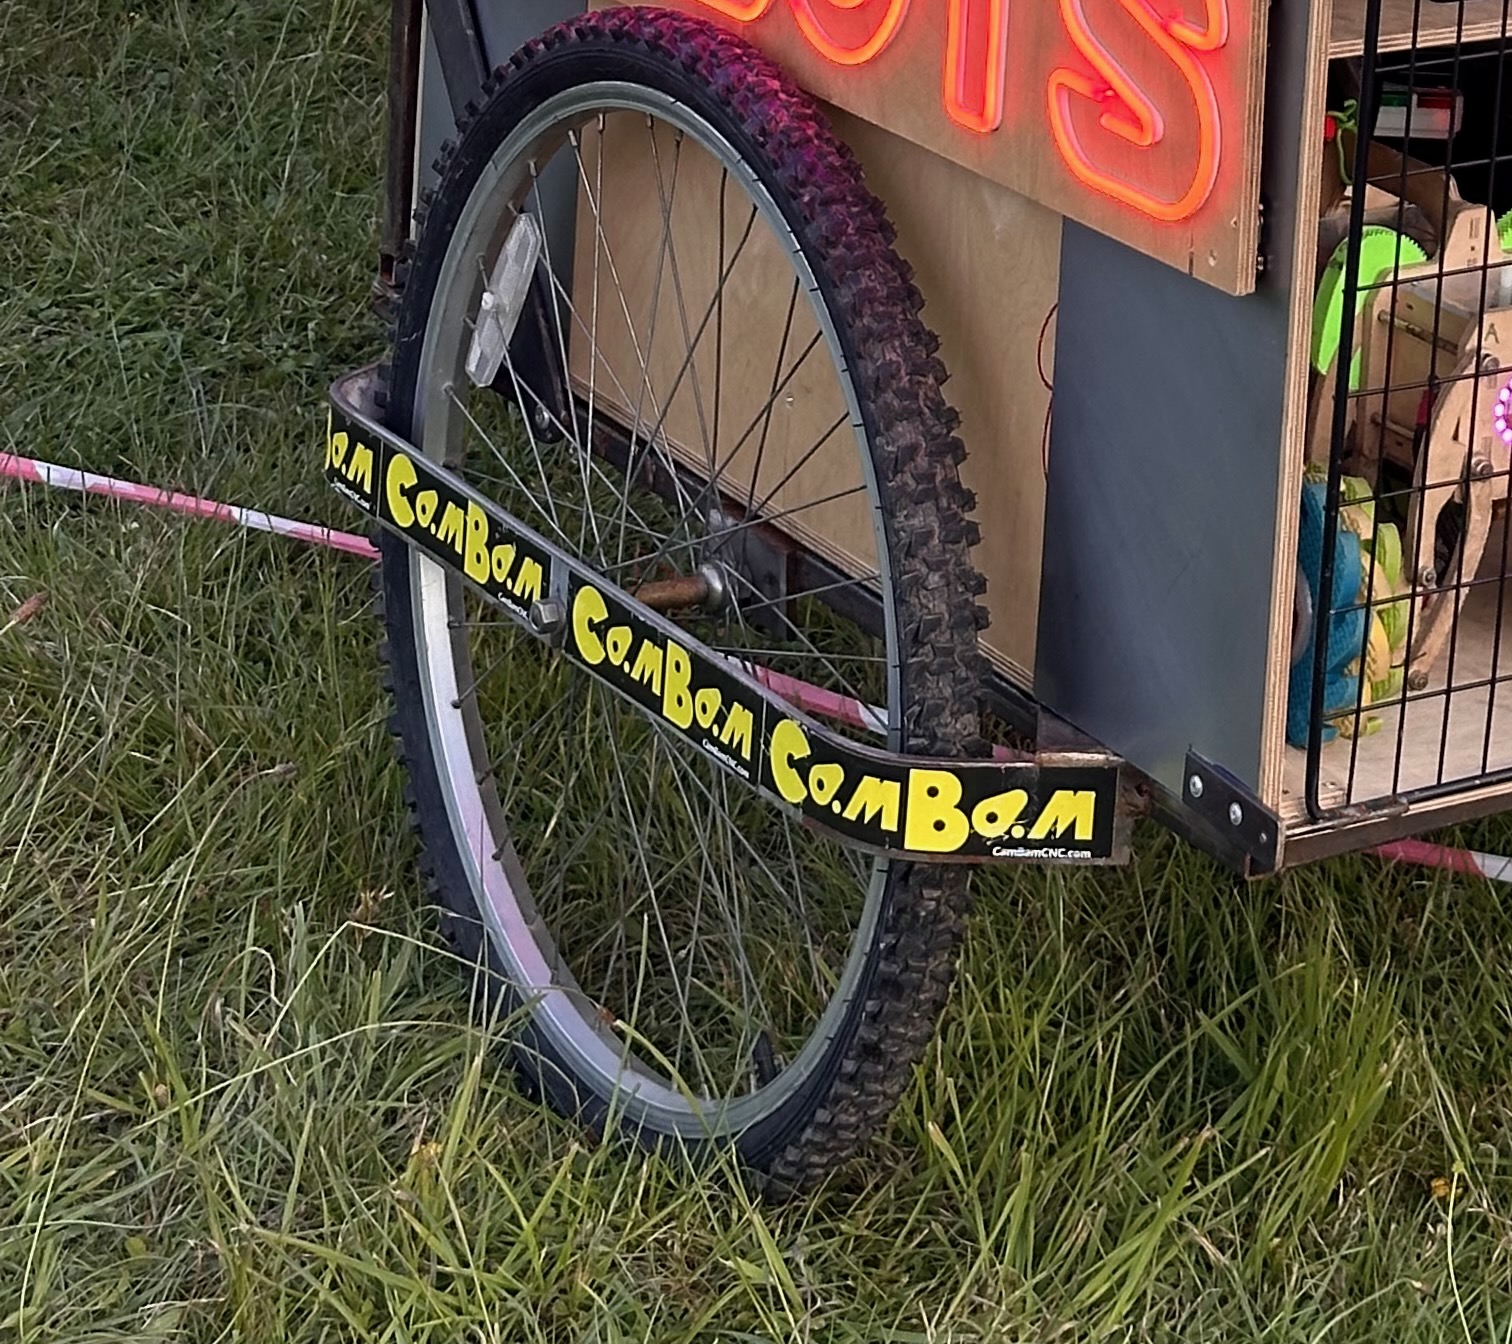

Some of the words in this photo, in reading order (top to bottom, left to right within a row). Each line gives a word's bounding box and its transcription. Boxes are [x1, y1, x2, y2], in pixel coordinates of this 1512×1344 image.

[1484, 323, 1499, 344] A
[572, 585, 753, 761] CamBam
[771, 719, 1095, 852] CamBam
[992, 846, 1091, 858] CamBamCNC.com
